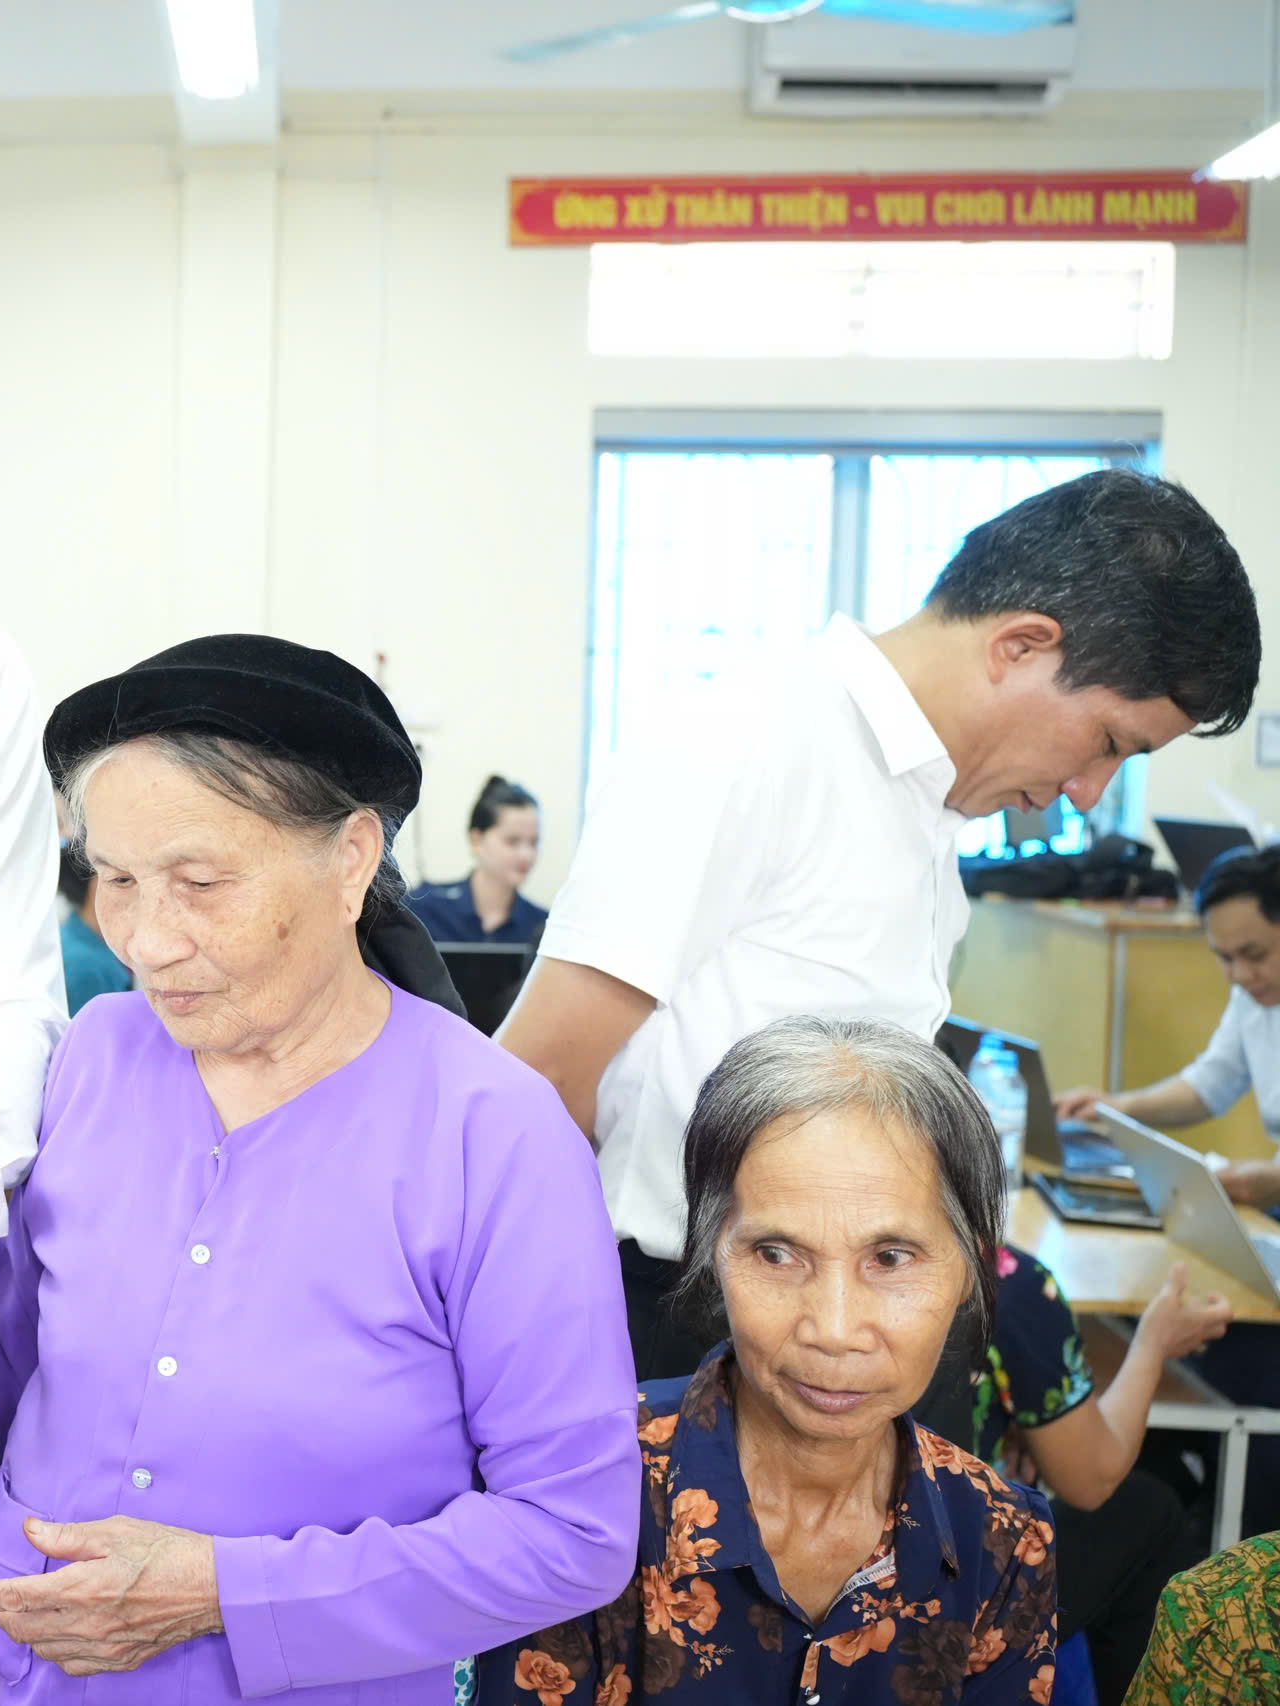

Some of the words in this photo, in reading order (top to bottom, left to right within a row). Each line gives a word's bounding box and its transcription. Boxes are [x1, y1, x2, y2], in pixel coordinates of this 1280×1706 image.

[761, 186, 848, 231] THIỆN
[875, 192, 926, 226] VUI
[932, 190, 1007, 226] CHƠI
[1013, 186, 1095, 225] LÀNH
[1103, 190, 1198, 230] MẠNH
